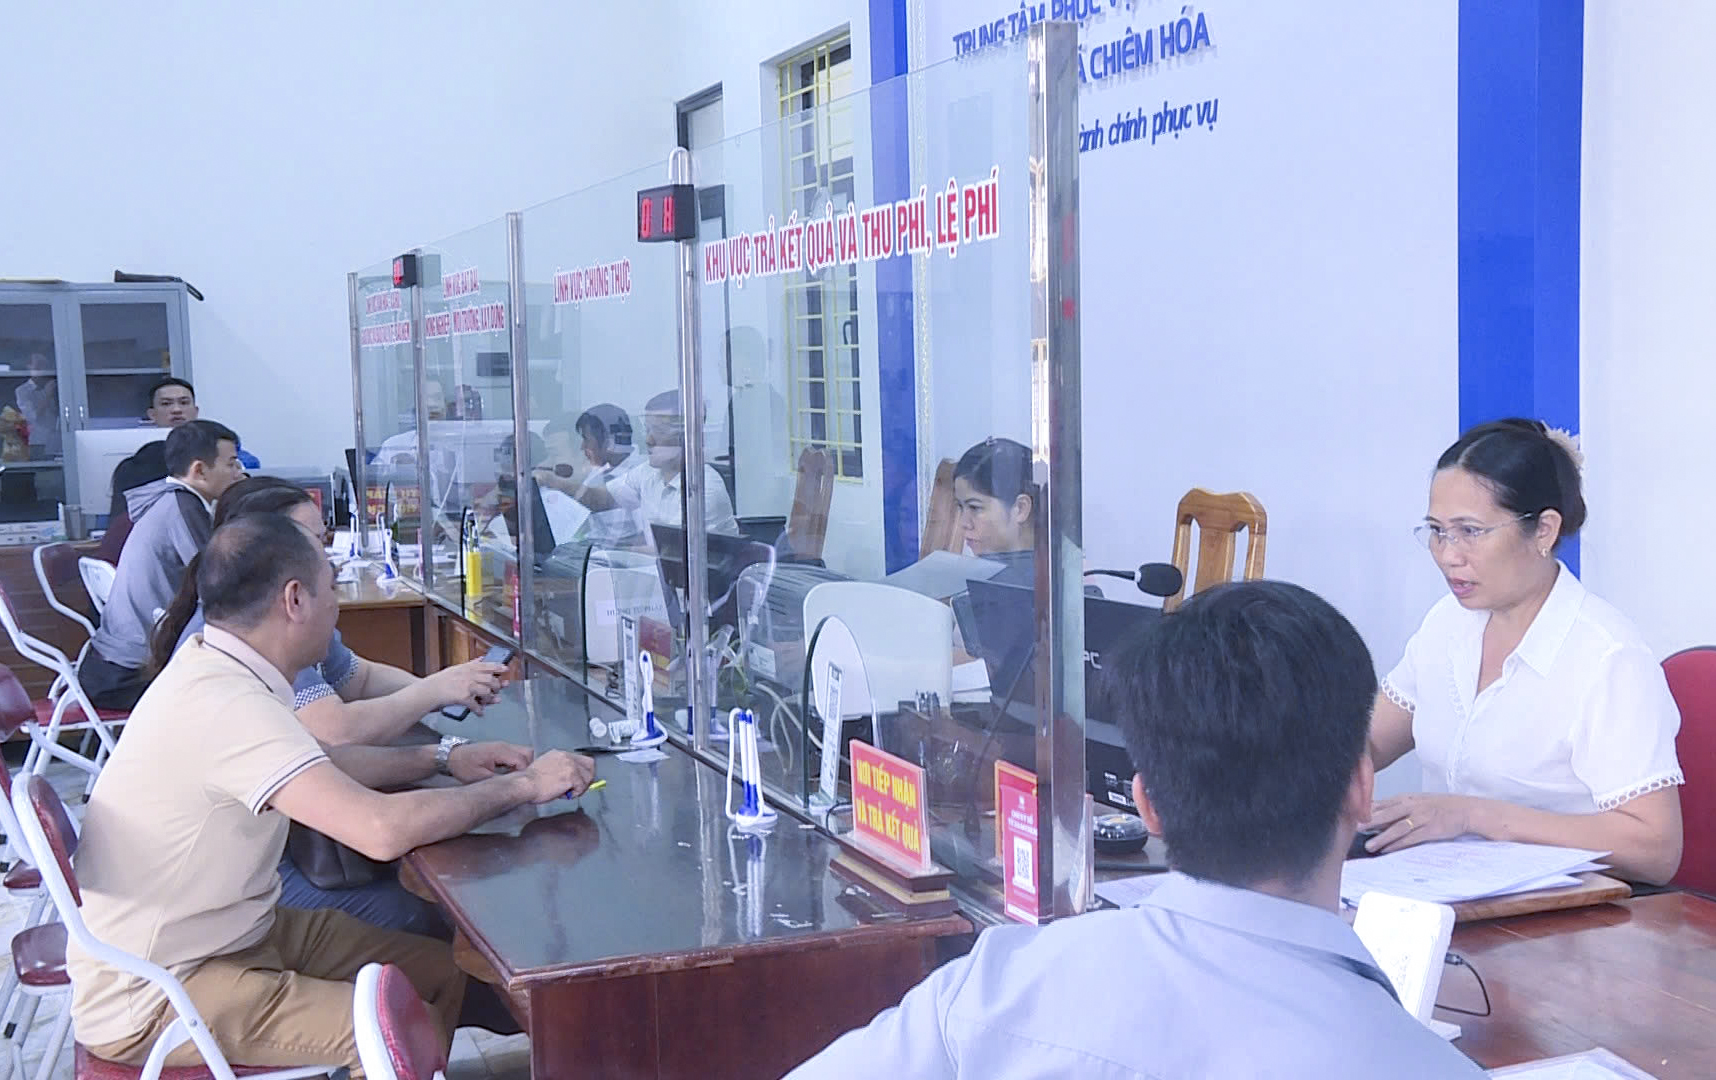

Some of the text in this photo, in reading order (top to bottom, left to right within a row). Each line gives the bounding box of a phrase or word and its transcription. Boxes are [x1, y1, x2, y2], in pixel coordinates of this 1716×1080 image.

[953, 17, 1005, 56] TRUNG
[1008, 2, 1045, 36] TÂM
[1090, 27, 1153, 80] CHIÊM
[1160, 6, 1211, 59] HÓA
[1078, 98, 1218, 153] ành chính phục vụ
[705, 166, 999, 287] KHU VỰC TRẢ KẾT QUẢ VÀ THU PHÍ, LỆ PHÍ
[871, 762, 890, 795] TIẾP
[892, 776, 917, 812] NHẬN
[856, 796, 921, 855] VÀ TRẢ KẾT QUẢ
